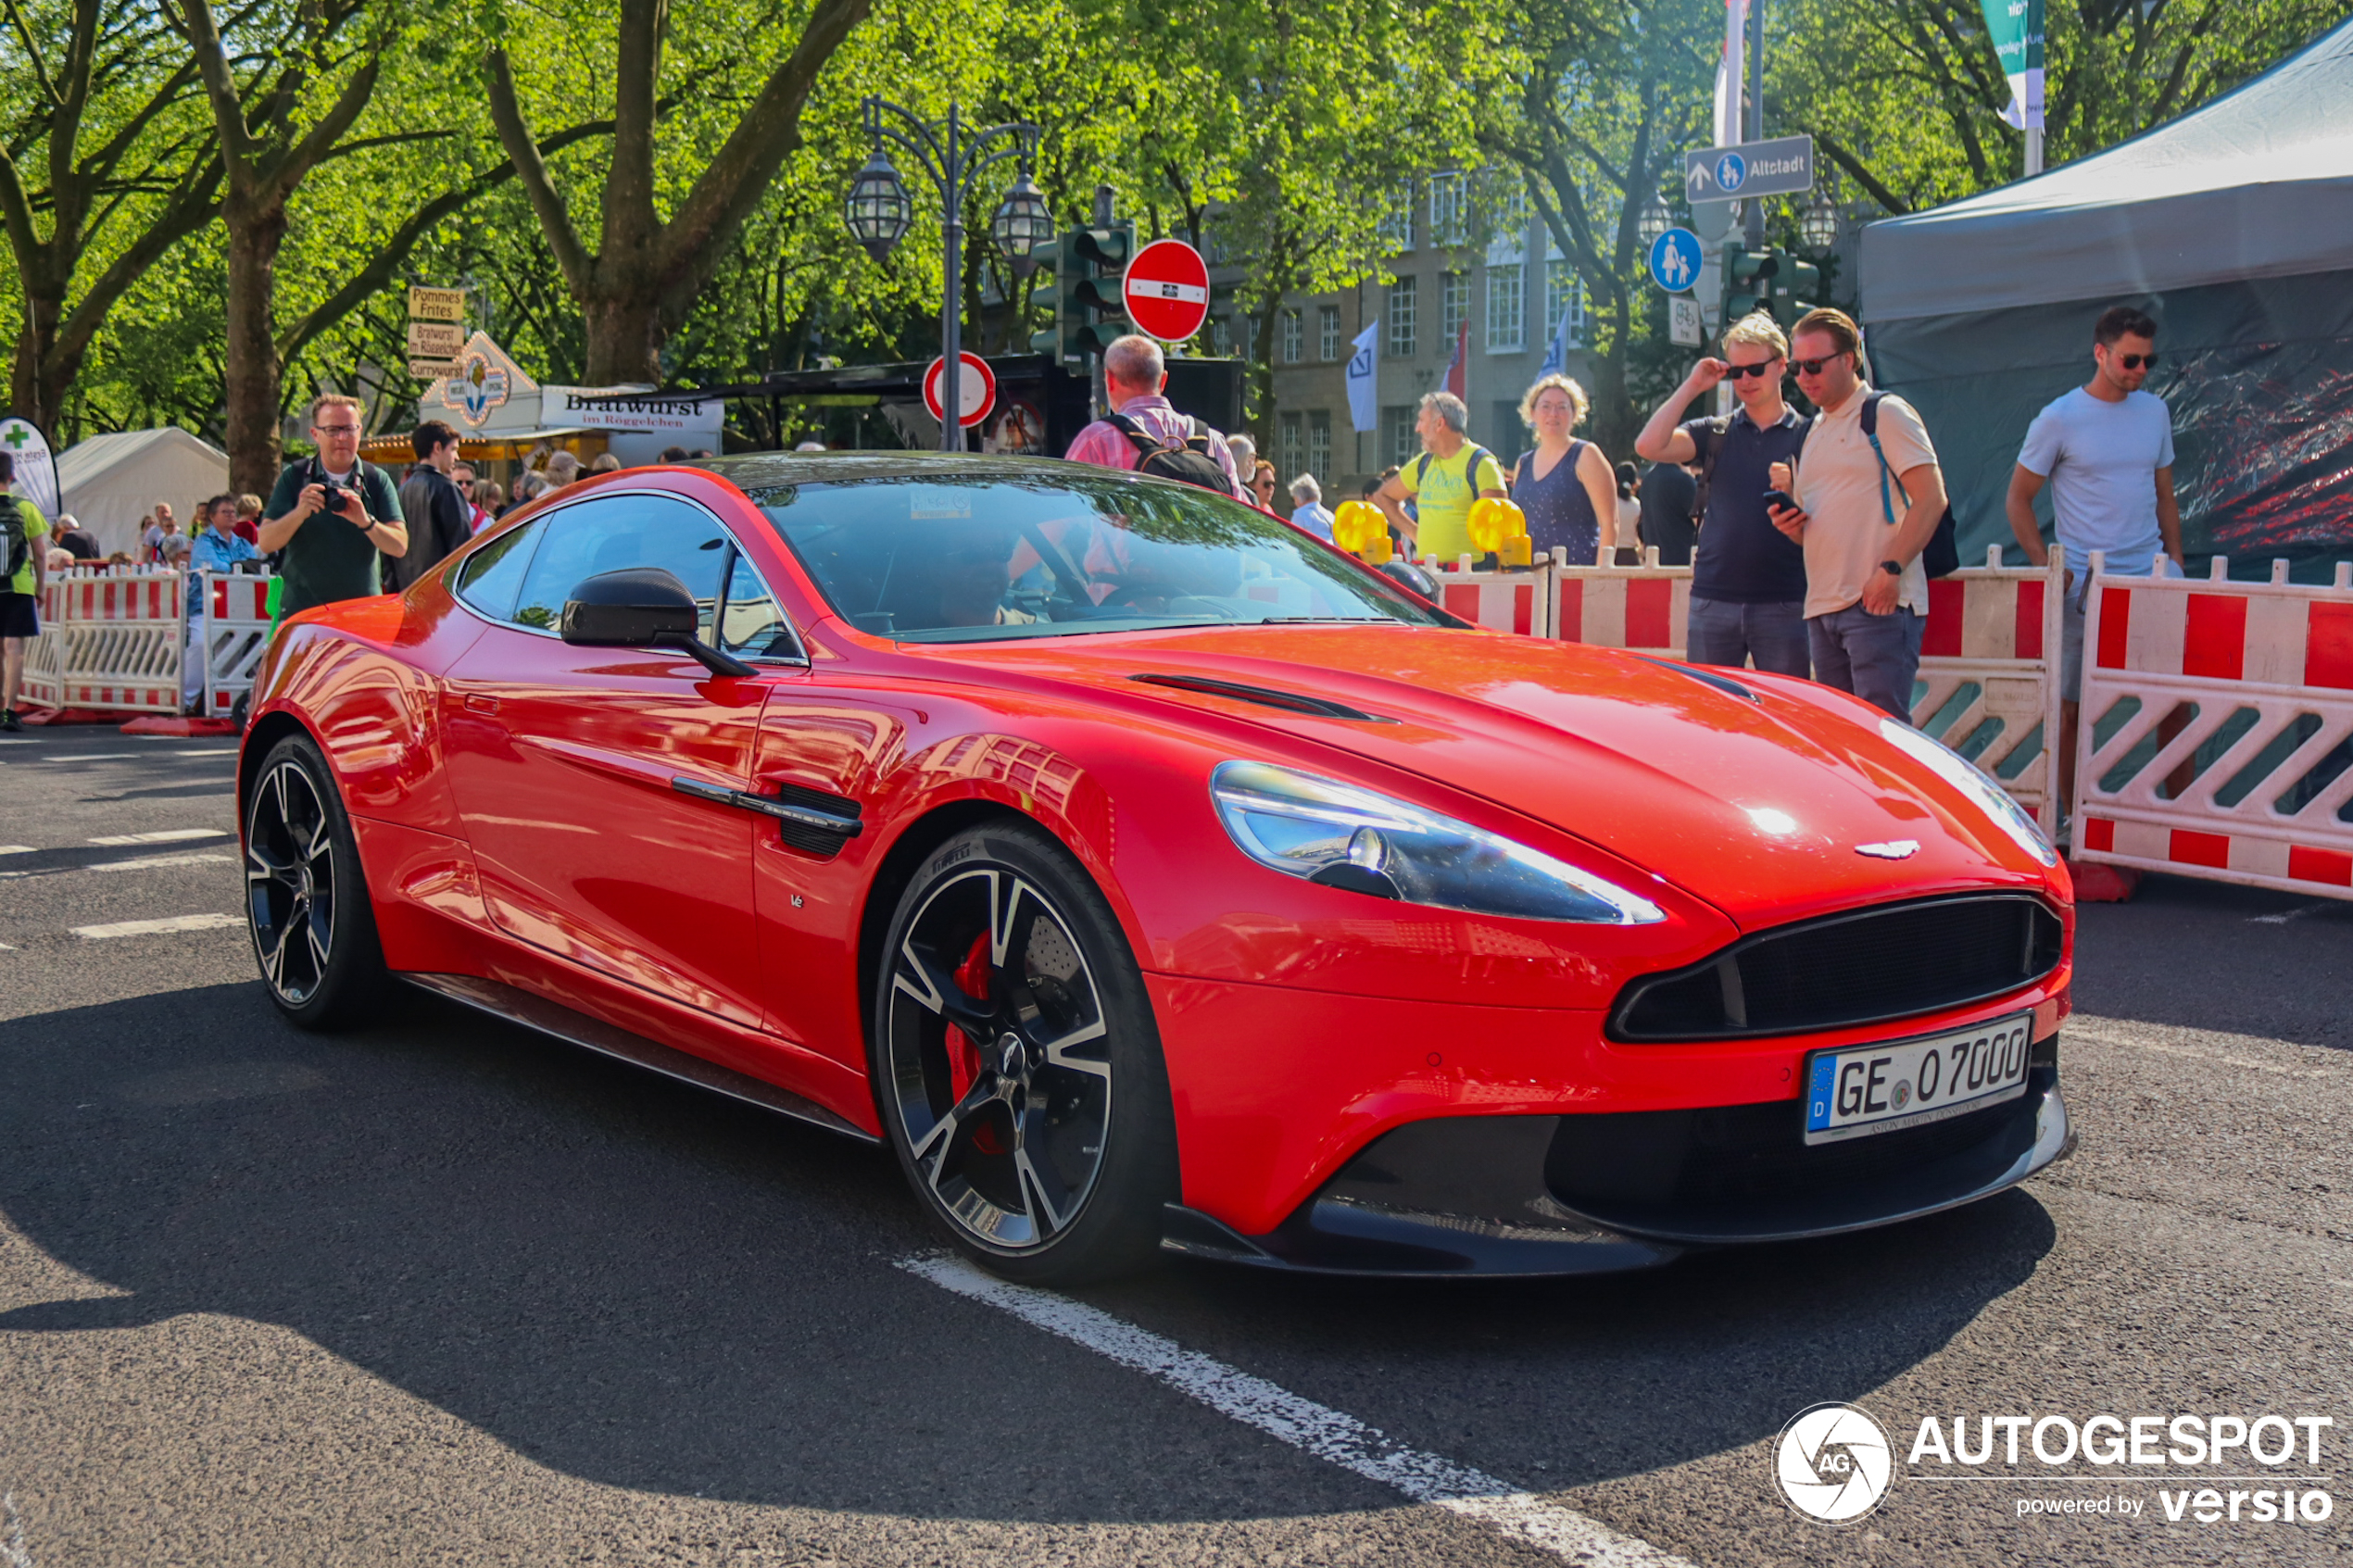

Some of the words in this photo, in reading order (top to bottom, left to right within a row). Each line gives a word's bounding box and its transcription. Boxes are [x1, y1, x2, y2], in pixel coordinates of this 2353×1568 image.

[1750, 155, 1805, 178] Altstadt
[413, 288, 460, 304] Pommes
[421, 303, 453, 317] Frites
[417, 326, 454, 341] Bratwurst
[409, 362, 463, 378] Currywurst
[565, 395, 702, 416] Bratwurst
[583, 414, 600, 424] im
[605, 415, 684, 428] Röggelchen
[932, 842, 971, 875] PIRELLI
[1837, 1057, 1892, 1117] GE
[1949, 1027, 2024, 1096] 7000
[1814, 1101, 1825, 1118] D
[1869, 1120, 1899, 1135] ASTON
[1903, 1112, 1934, 1128] MARTIN
